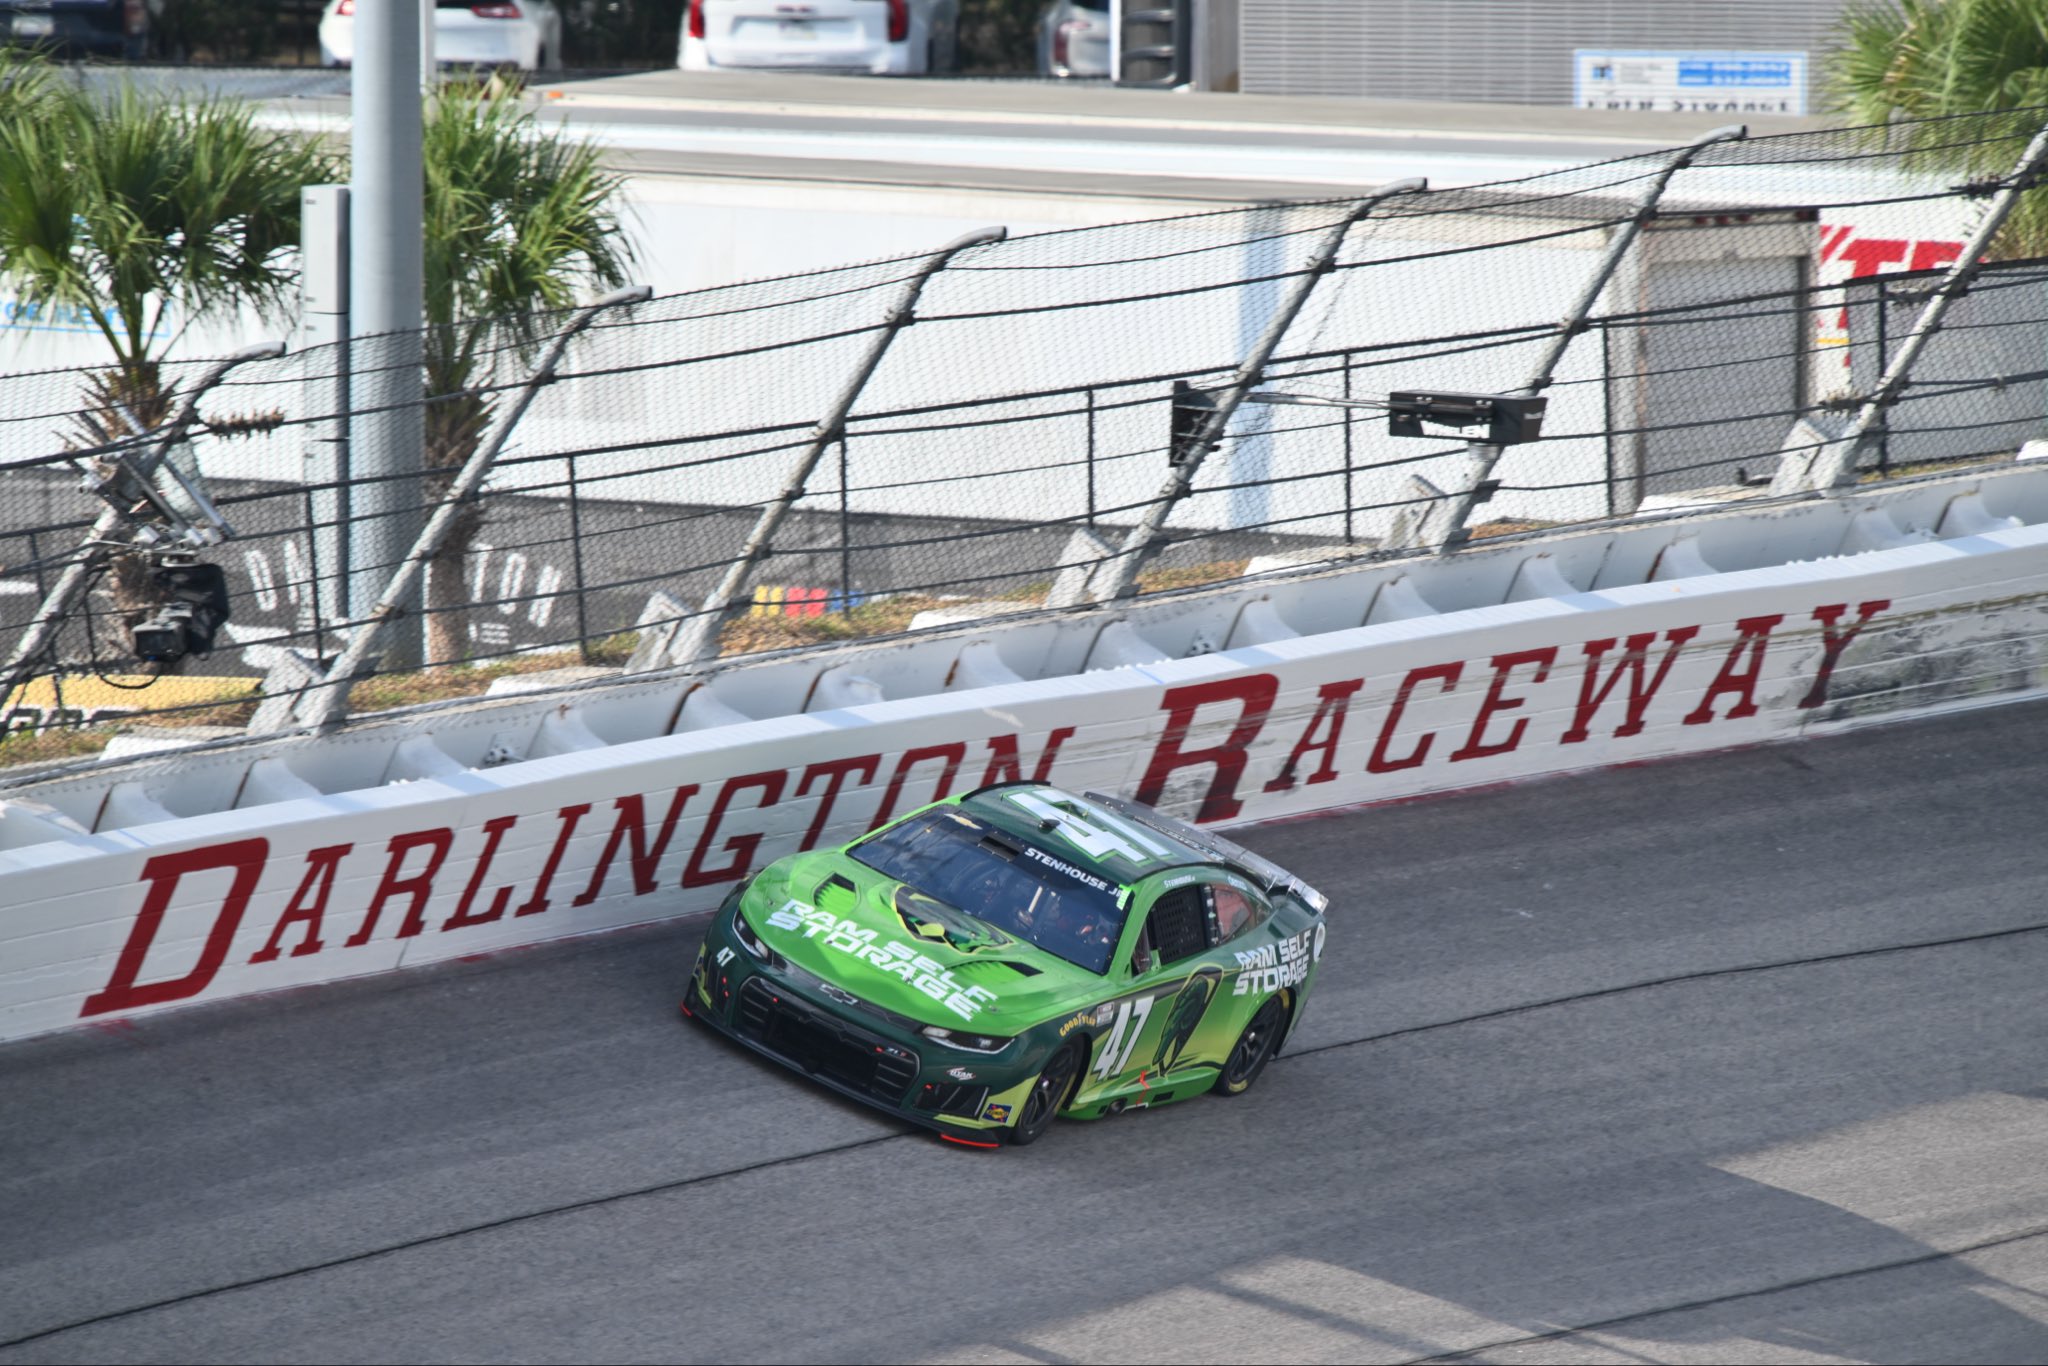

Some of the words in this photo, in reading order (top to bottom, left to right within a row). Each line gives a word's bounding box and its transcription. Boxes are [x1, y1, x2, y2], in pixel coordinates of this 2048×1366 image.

[1134, 600, 1891, 823] RACEWAY
[1024, 847, 1108, 891] STENHOUSE
[716, 946, 736, 968] 47
[765, 911, 983, 1022] STORAGE
[781, 898, 879, 942] RAM
[884, 940, 998, 1002] SELF
[1232, 955, 1309, 996] STORAGE
[1234, 944, 1278, 972] RAM
[1278, 930, 1312, 961] SELF
[1093, 995, 1155, 1081] 47
